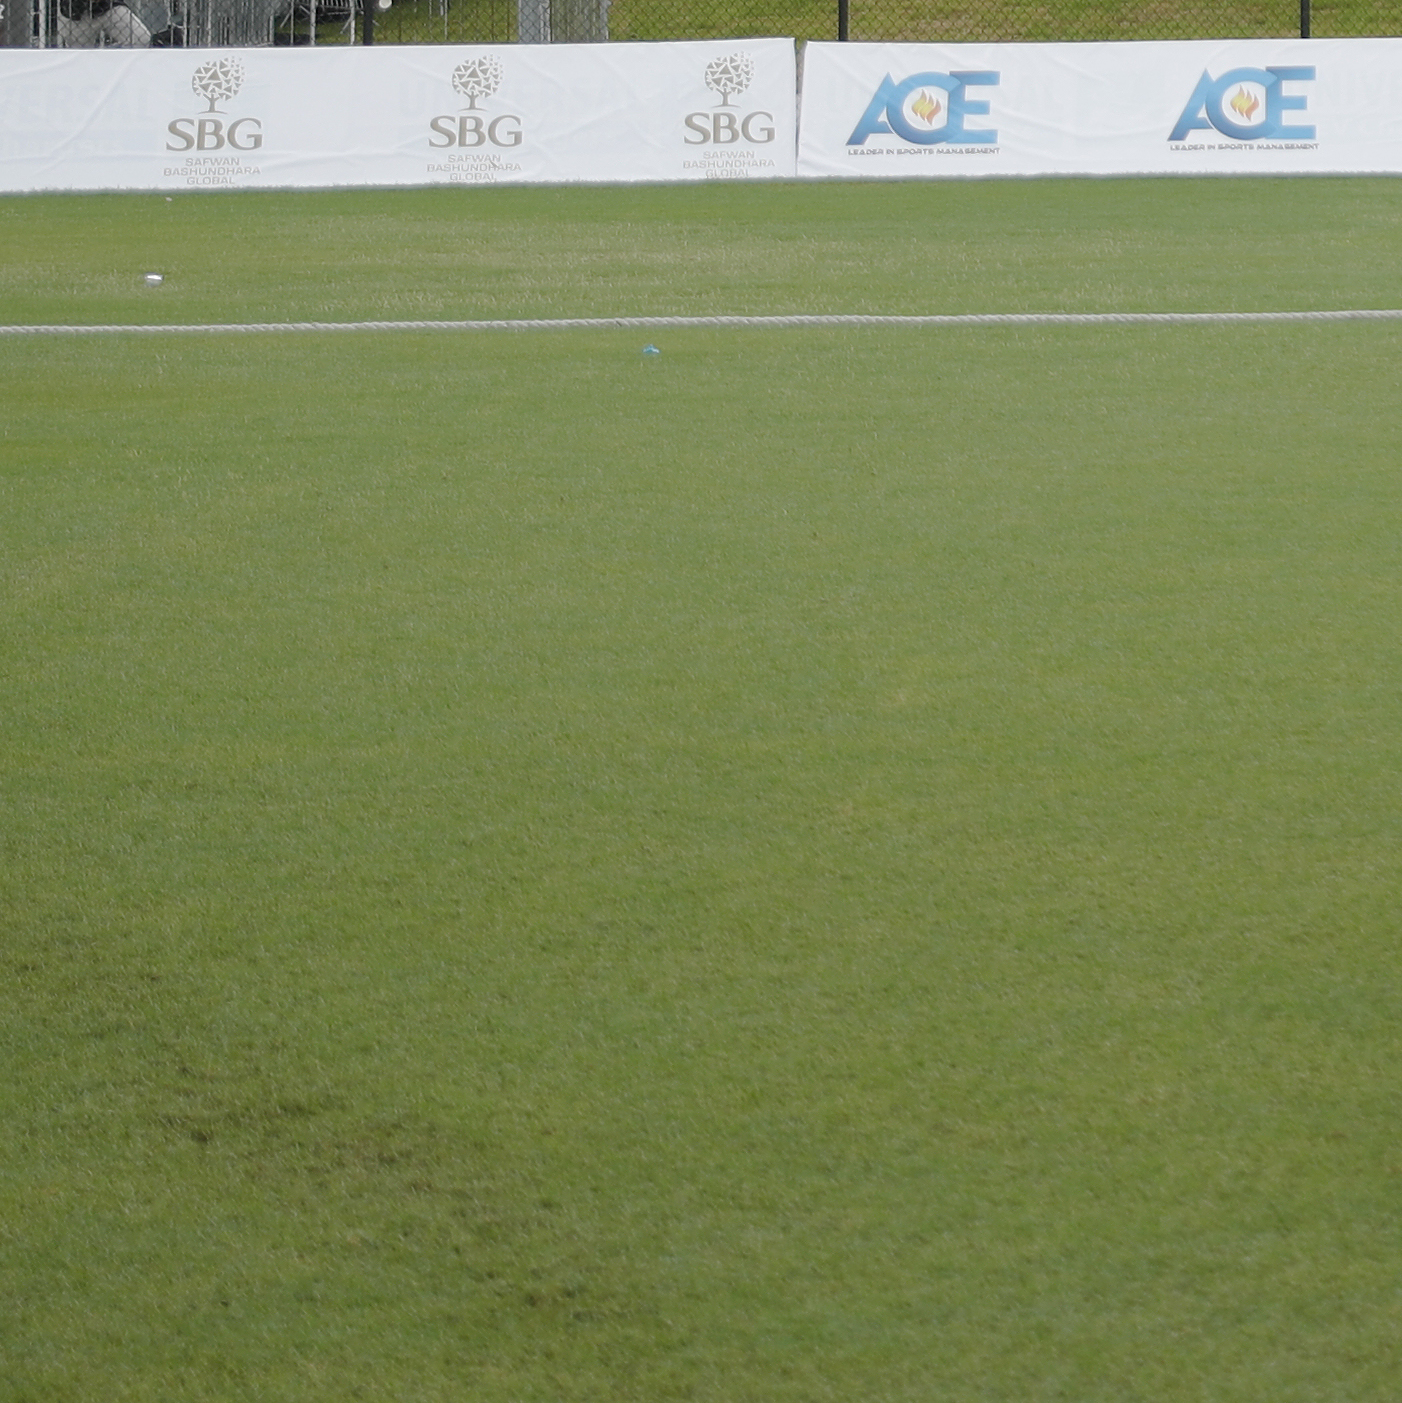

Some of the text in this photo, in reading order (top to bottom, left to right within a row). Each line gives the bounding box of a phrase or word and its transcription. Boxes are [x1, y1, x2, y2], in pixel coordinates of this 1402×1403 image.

[846, 71, 1000, 145] ACE
[1167, 66, 1316, 141] ACE
[428, 115, 523, 148] SBG
[683, 111, 776, 145] SBG
[166, 117, 263, 152] SBG
[703, 150, 755, 159] SAFWAN
[936, 147, 1000, 155] MANAGEMENT
[185, 157, 240, 167] SAFWAN
[448, 154, 501, 163] SAFWAN
[427, 163, 522, 173] BASHUNDHARA
[683, 159, 776, 169] BASHUNDHARA
[164, 166, 261, 176] BASHUNDHARA
[705, 168, 750, 178] GLOBAL
[186, 176, 236, 185] GLOBAL
[450, 172, 497, 182] GLOBAL
